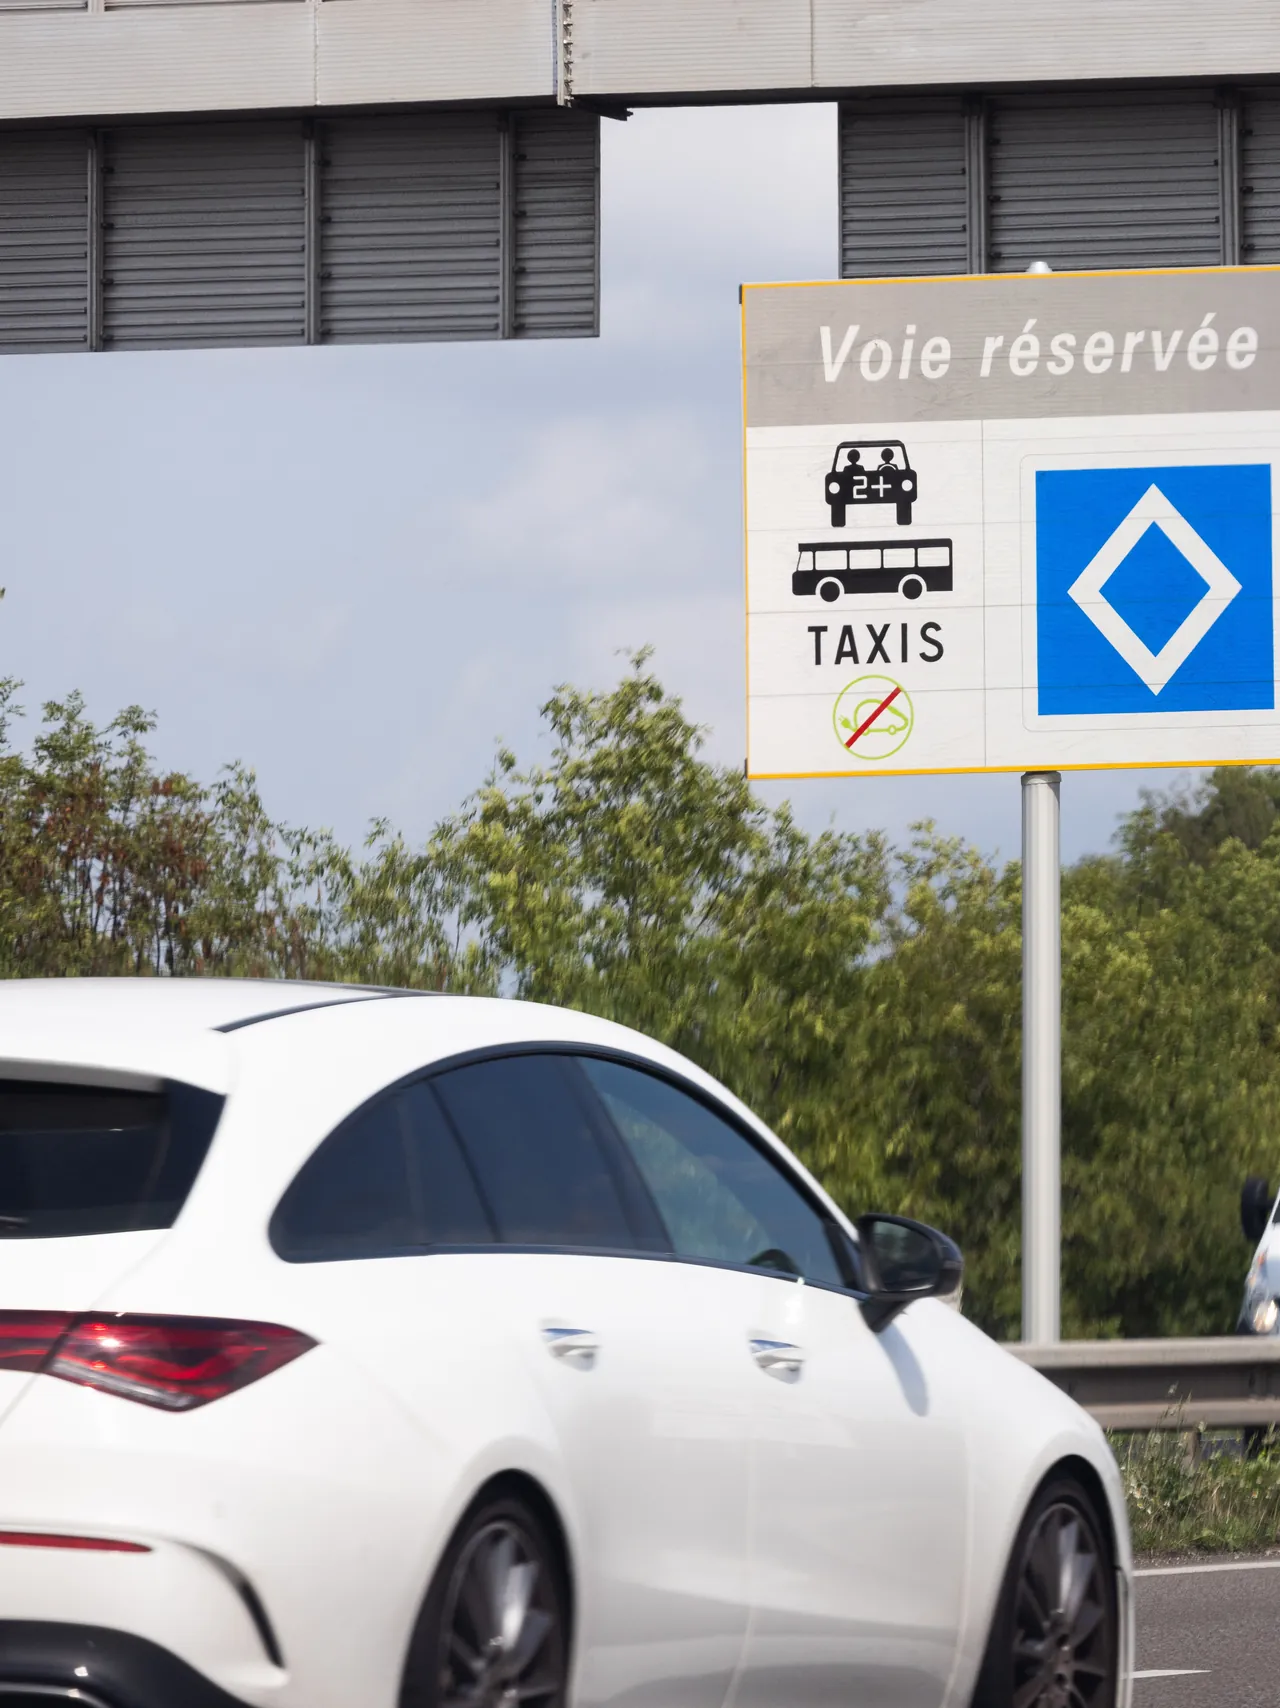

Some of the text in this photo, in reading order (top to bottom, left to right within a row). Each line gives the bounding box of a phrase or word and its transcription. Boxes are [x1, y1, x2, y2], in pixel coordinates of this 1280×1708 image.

[819, 312, 1259, 383] Voie réservée
[852, 475, 892, 499] 2+
[807, 621, 944, 666] TAXIS
